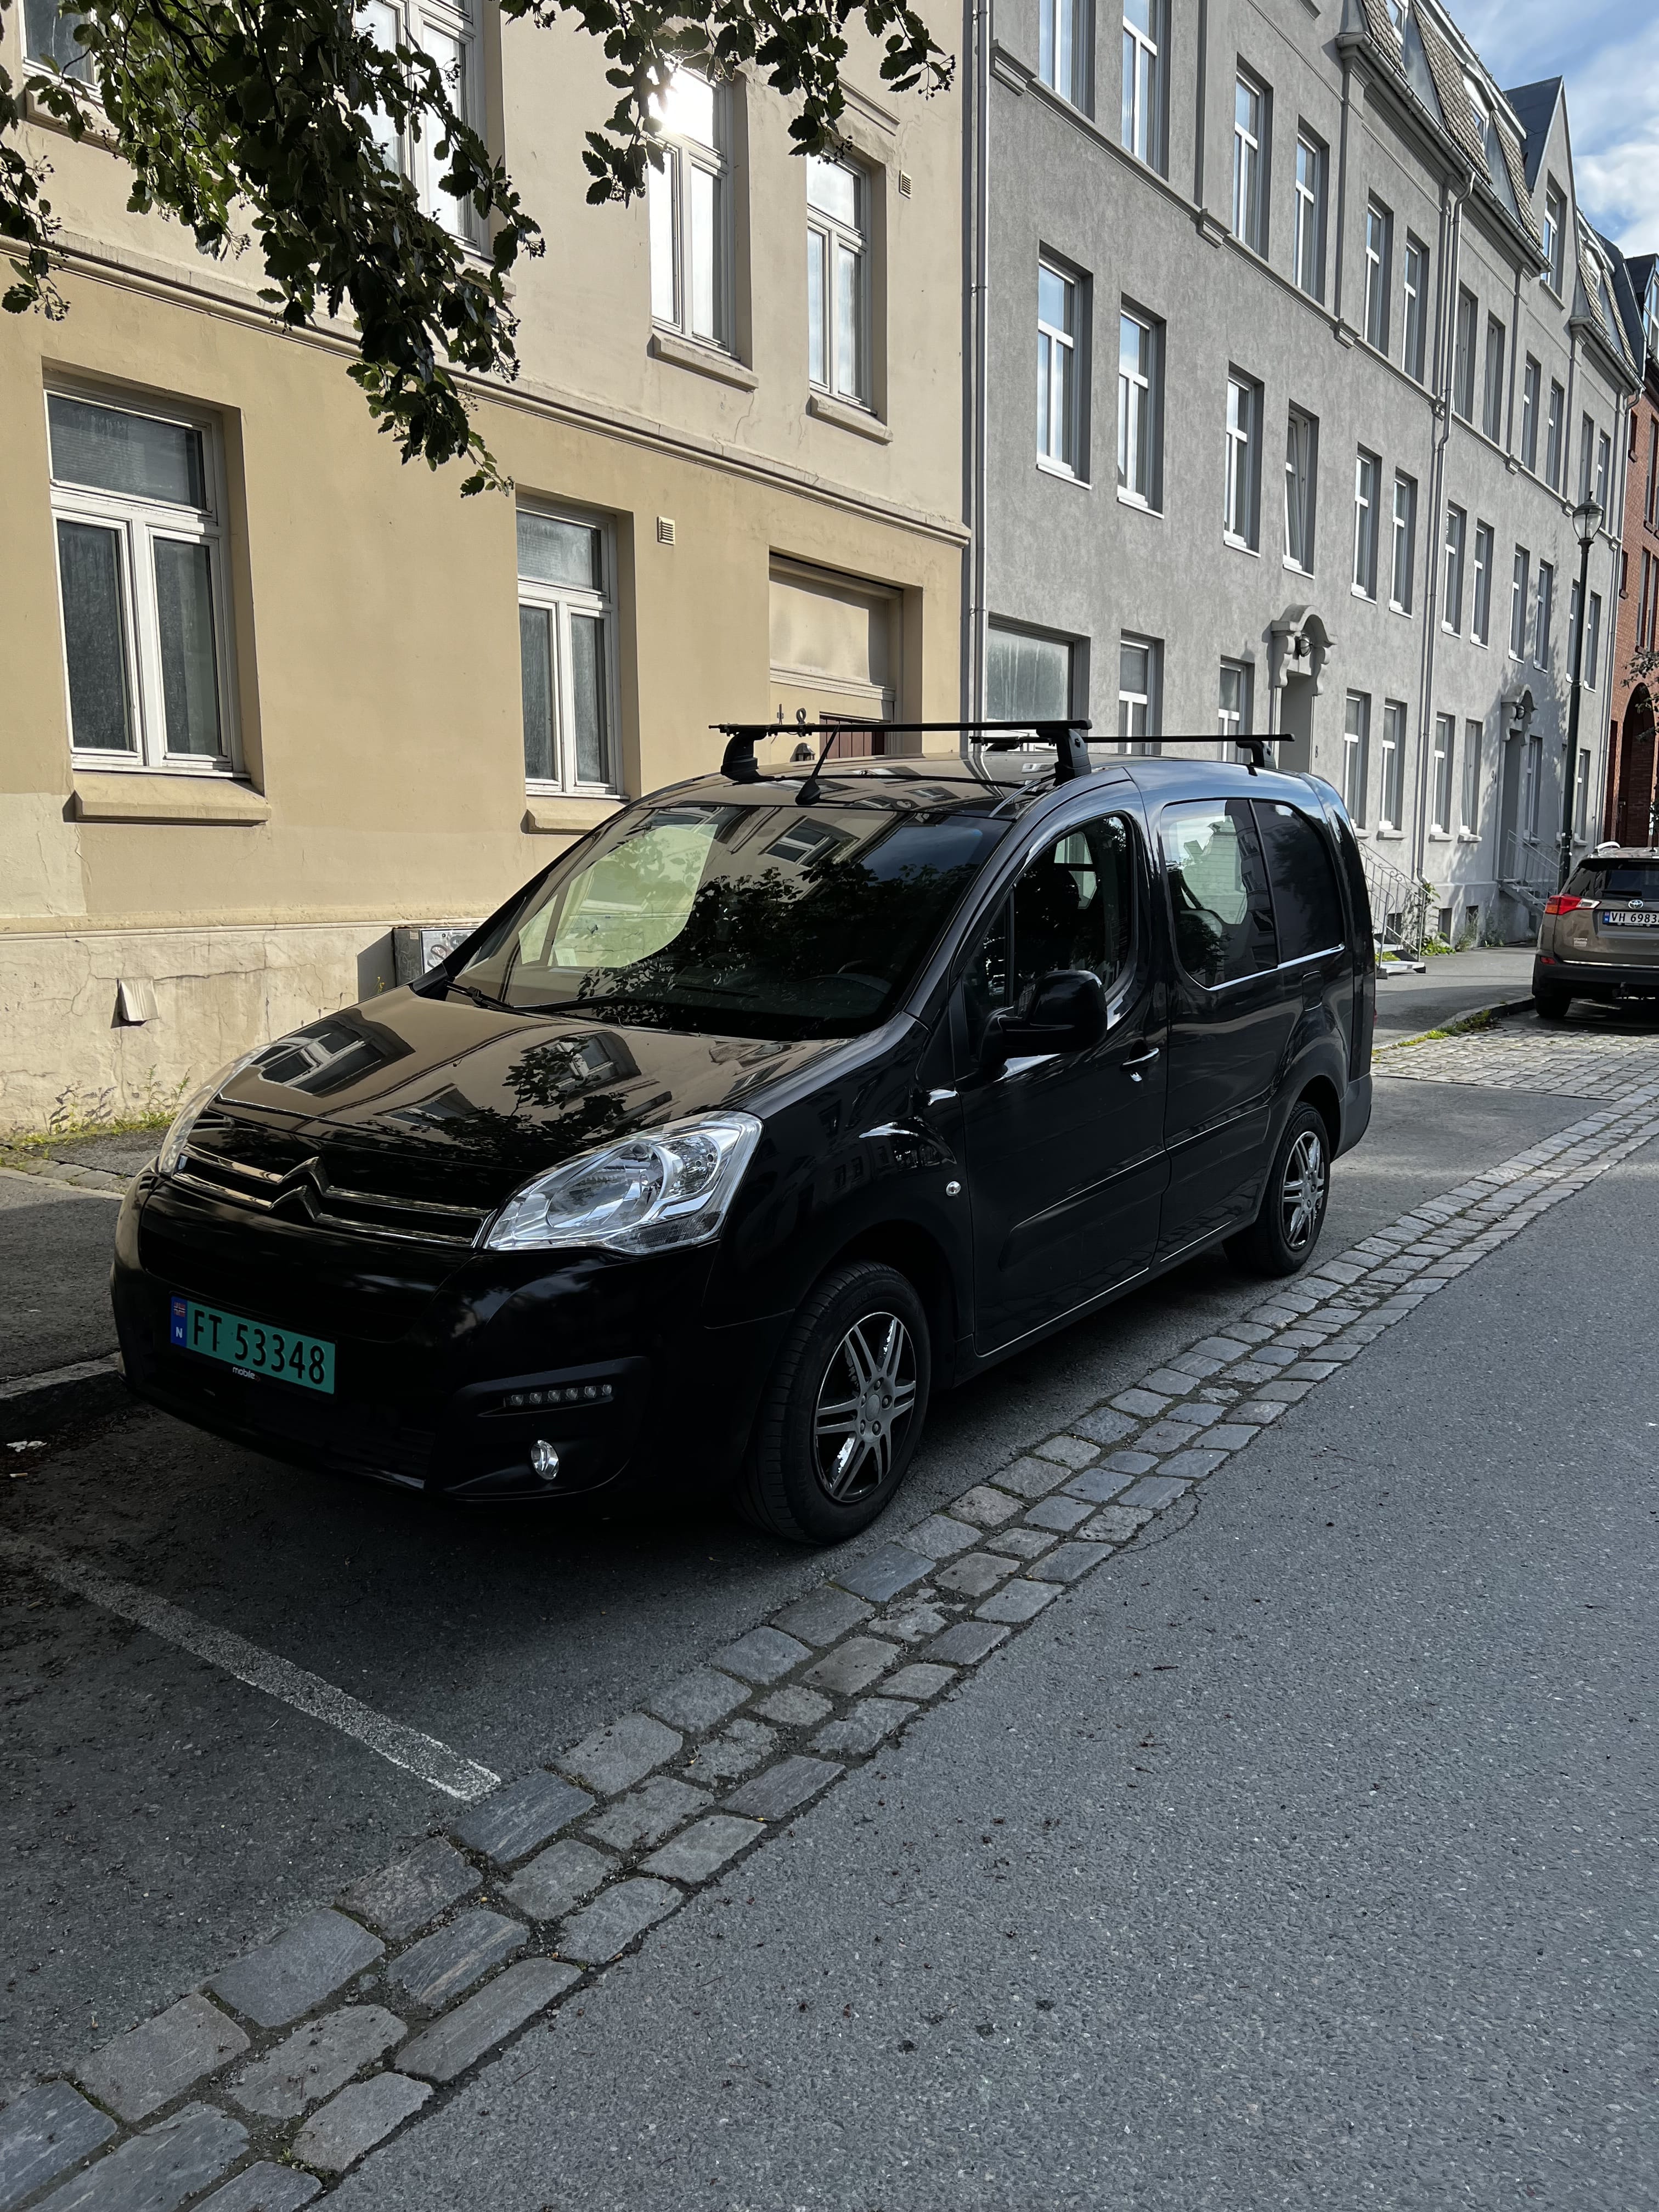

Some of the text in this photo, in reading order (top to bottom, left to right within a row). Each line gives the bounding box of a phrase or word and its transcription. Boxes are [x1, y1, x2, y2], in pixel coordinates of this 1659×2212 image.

[1612, 913, 1659, 923] VH 6983
[176, 1327, 183, 1338] N
[194, 1310, 325, 1384] FT 53348
